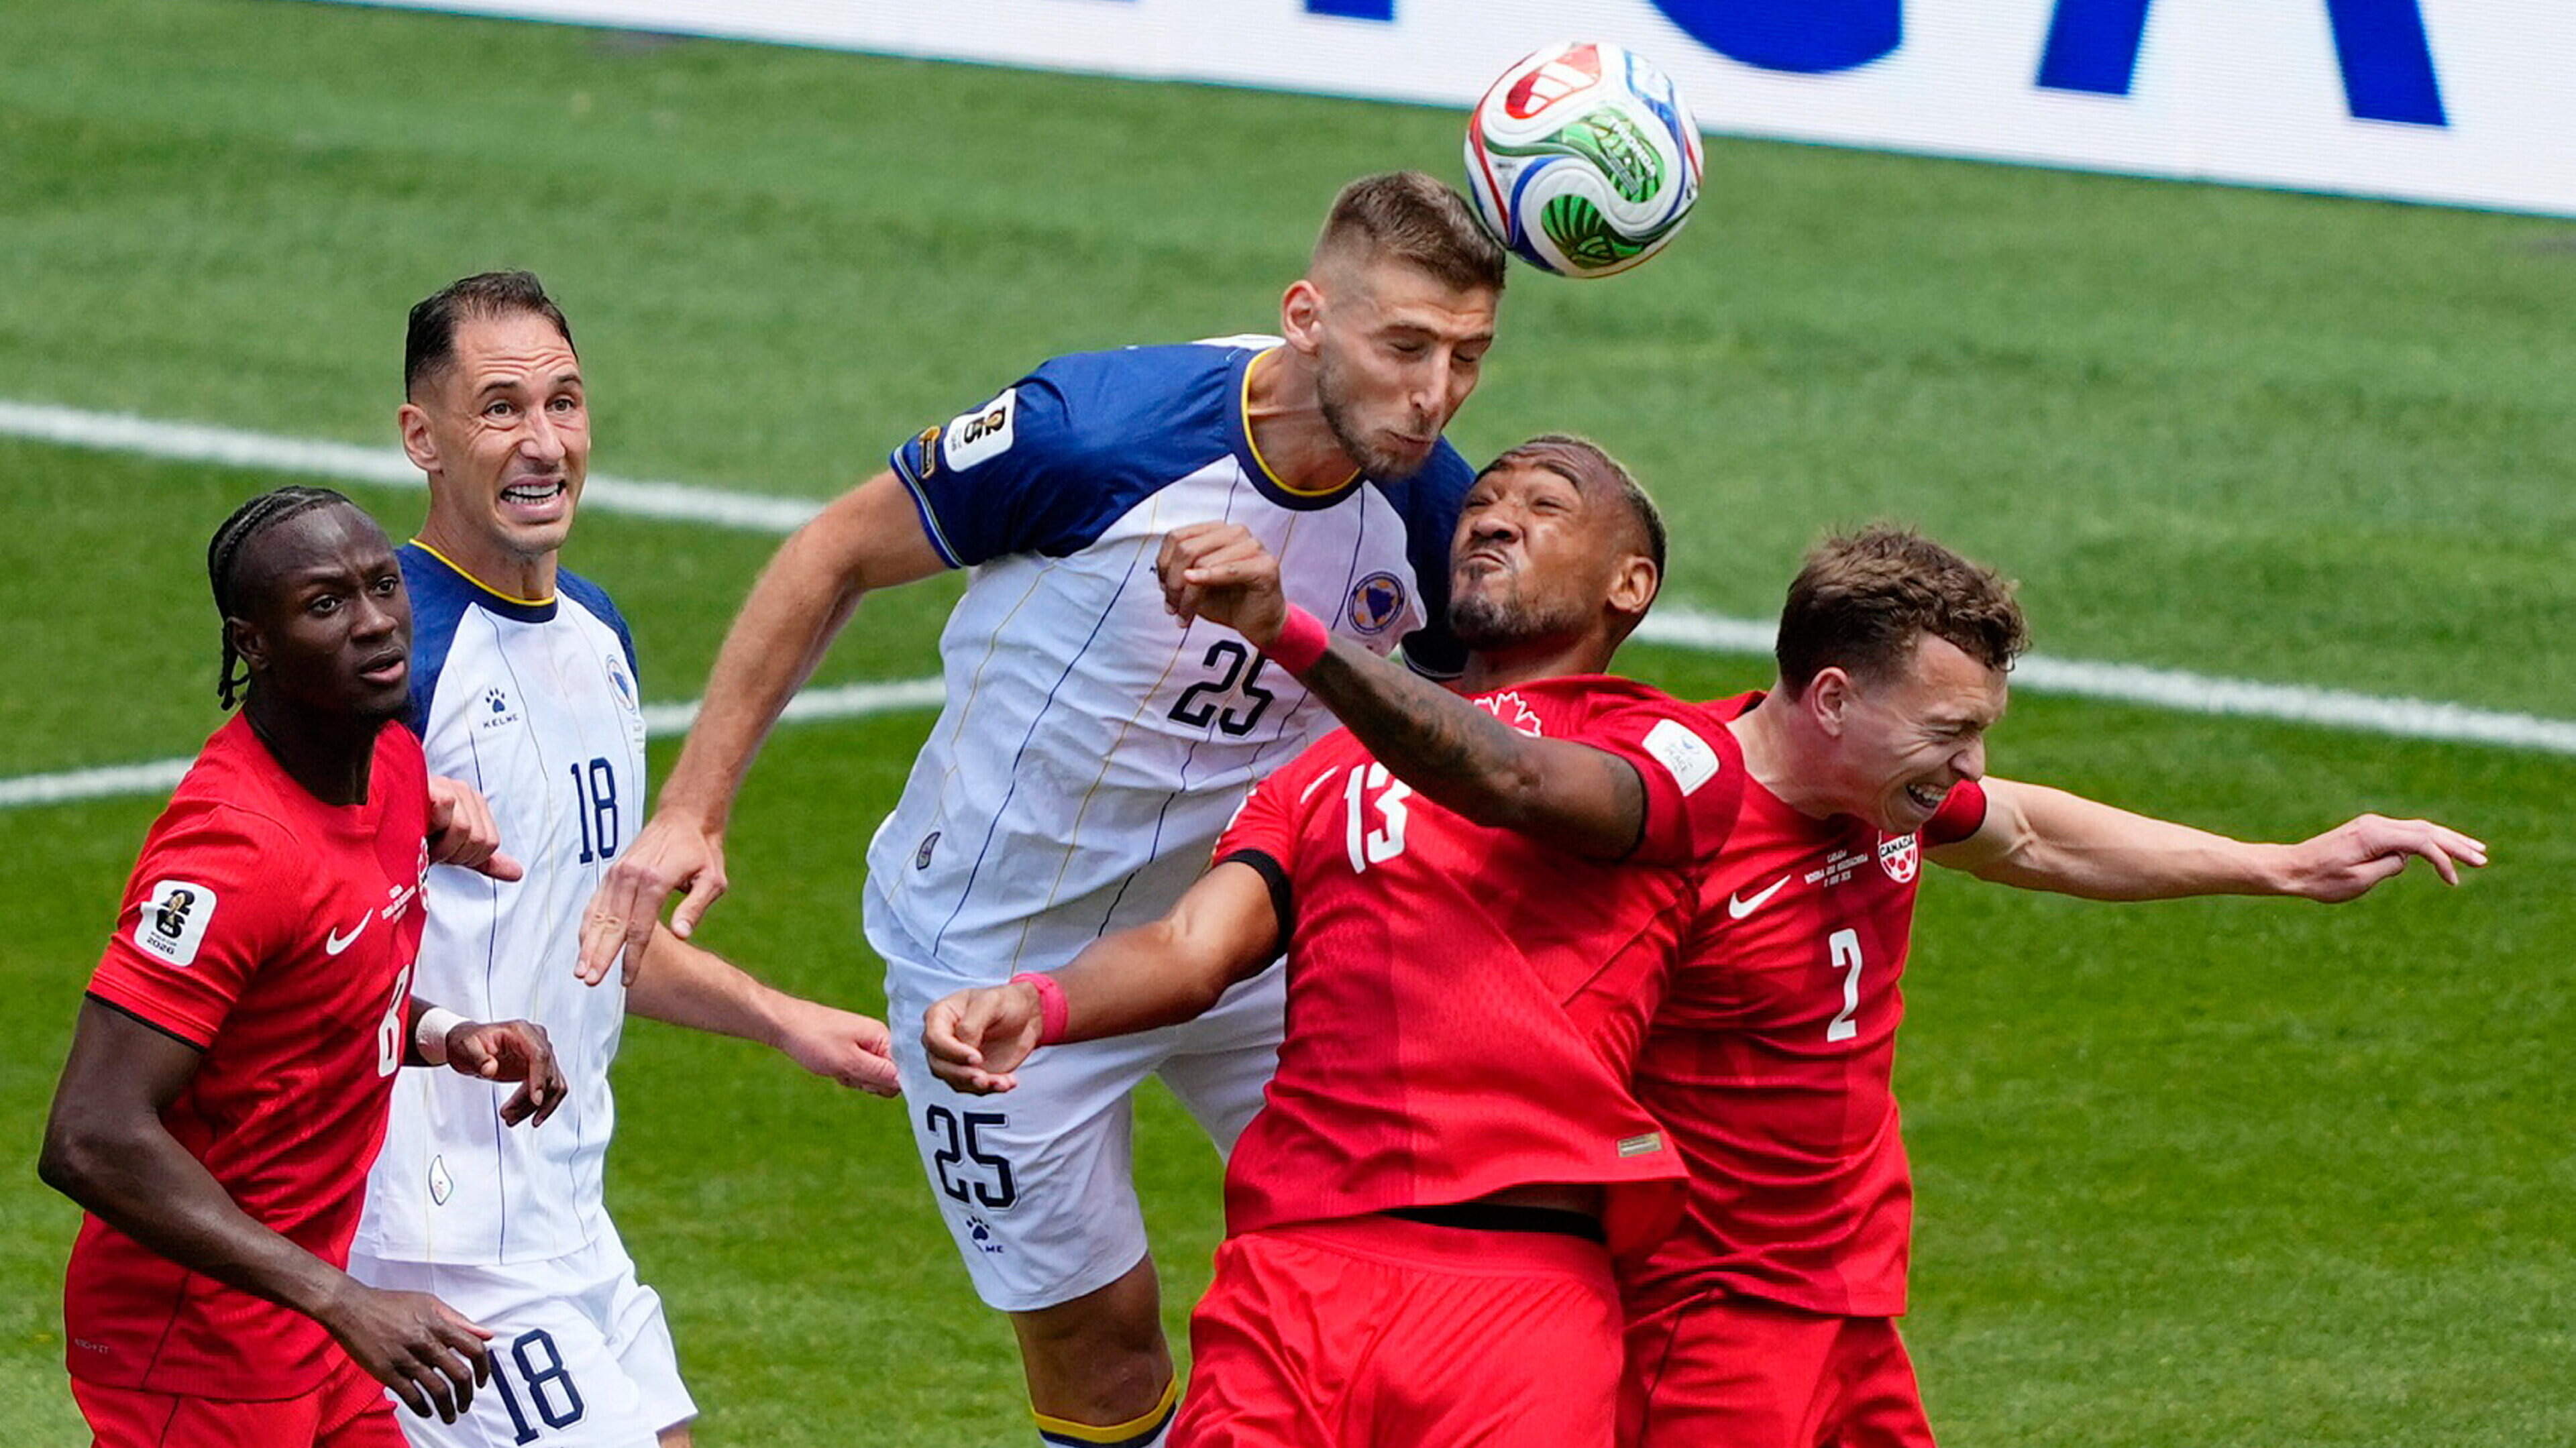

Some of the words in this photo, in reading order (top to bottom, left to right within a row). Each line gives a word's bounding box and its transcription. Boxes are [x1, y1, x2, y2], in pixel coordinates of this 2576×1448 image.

[482, 713, 519, 729] KELME
[1167, 640, 1275, 736] 25
[570, 757, 618, 865] 18
[1343, 761, 1413, 875] 13
[1880, 835, 1915, 858] CANADA
[146, 936, 176, 955] 2026
[1827, 928, 1862, 1042] 2
[378, 963, 410, 1078] 8
[926, 1104, 1017, 1208] 25
[488, 1328, 585, 1447] 18
